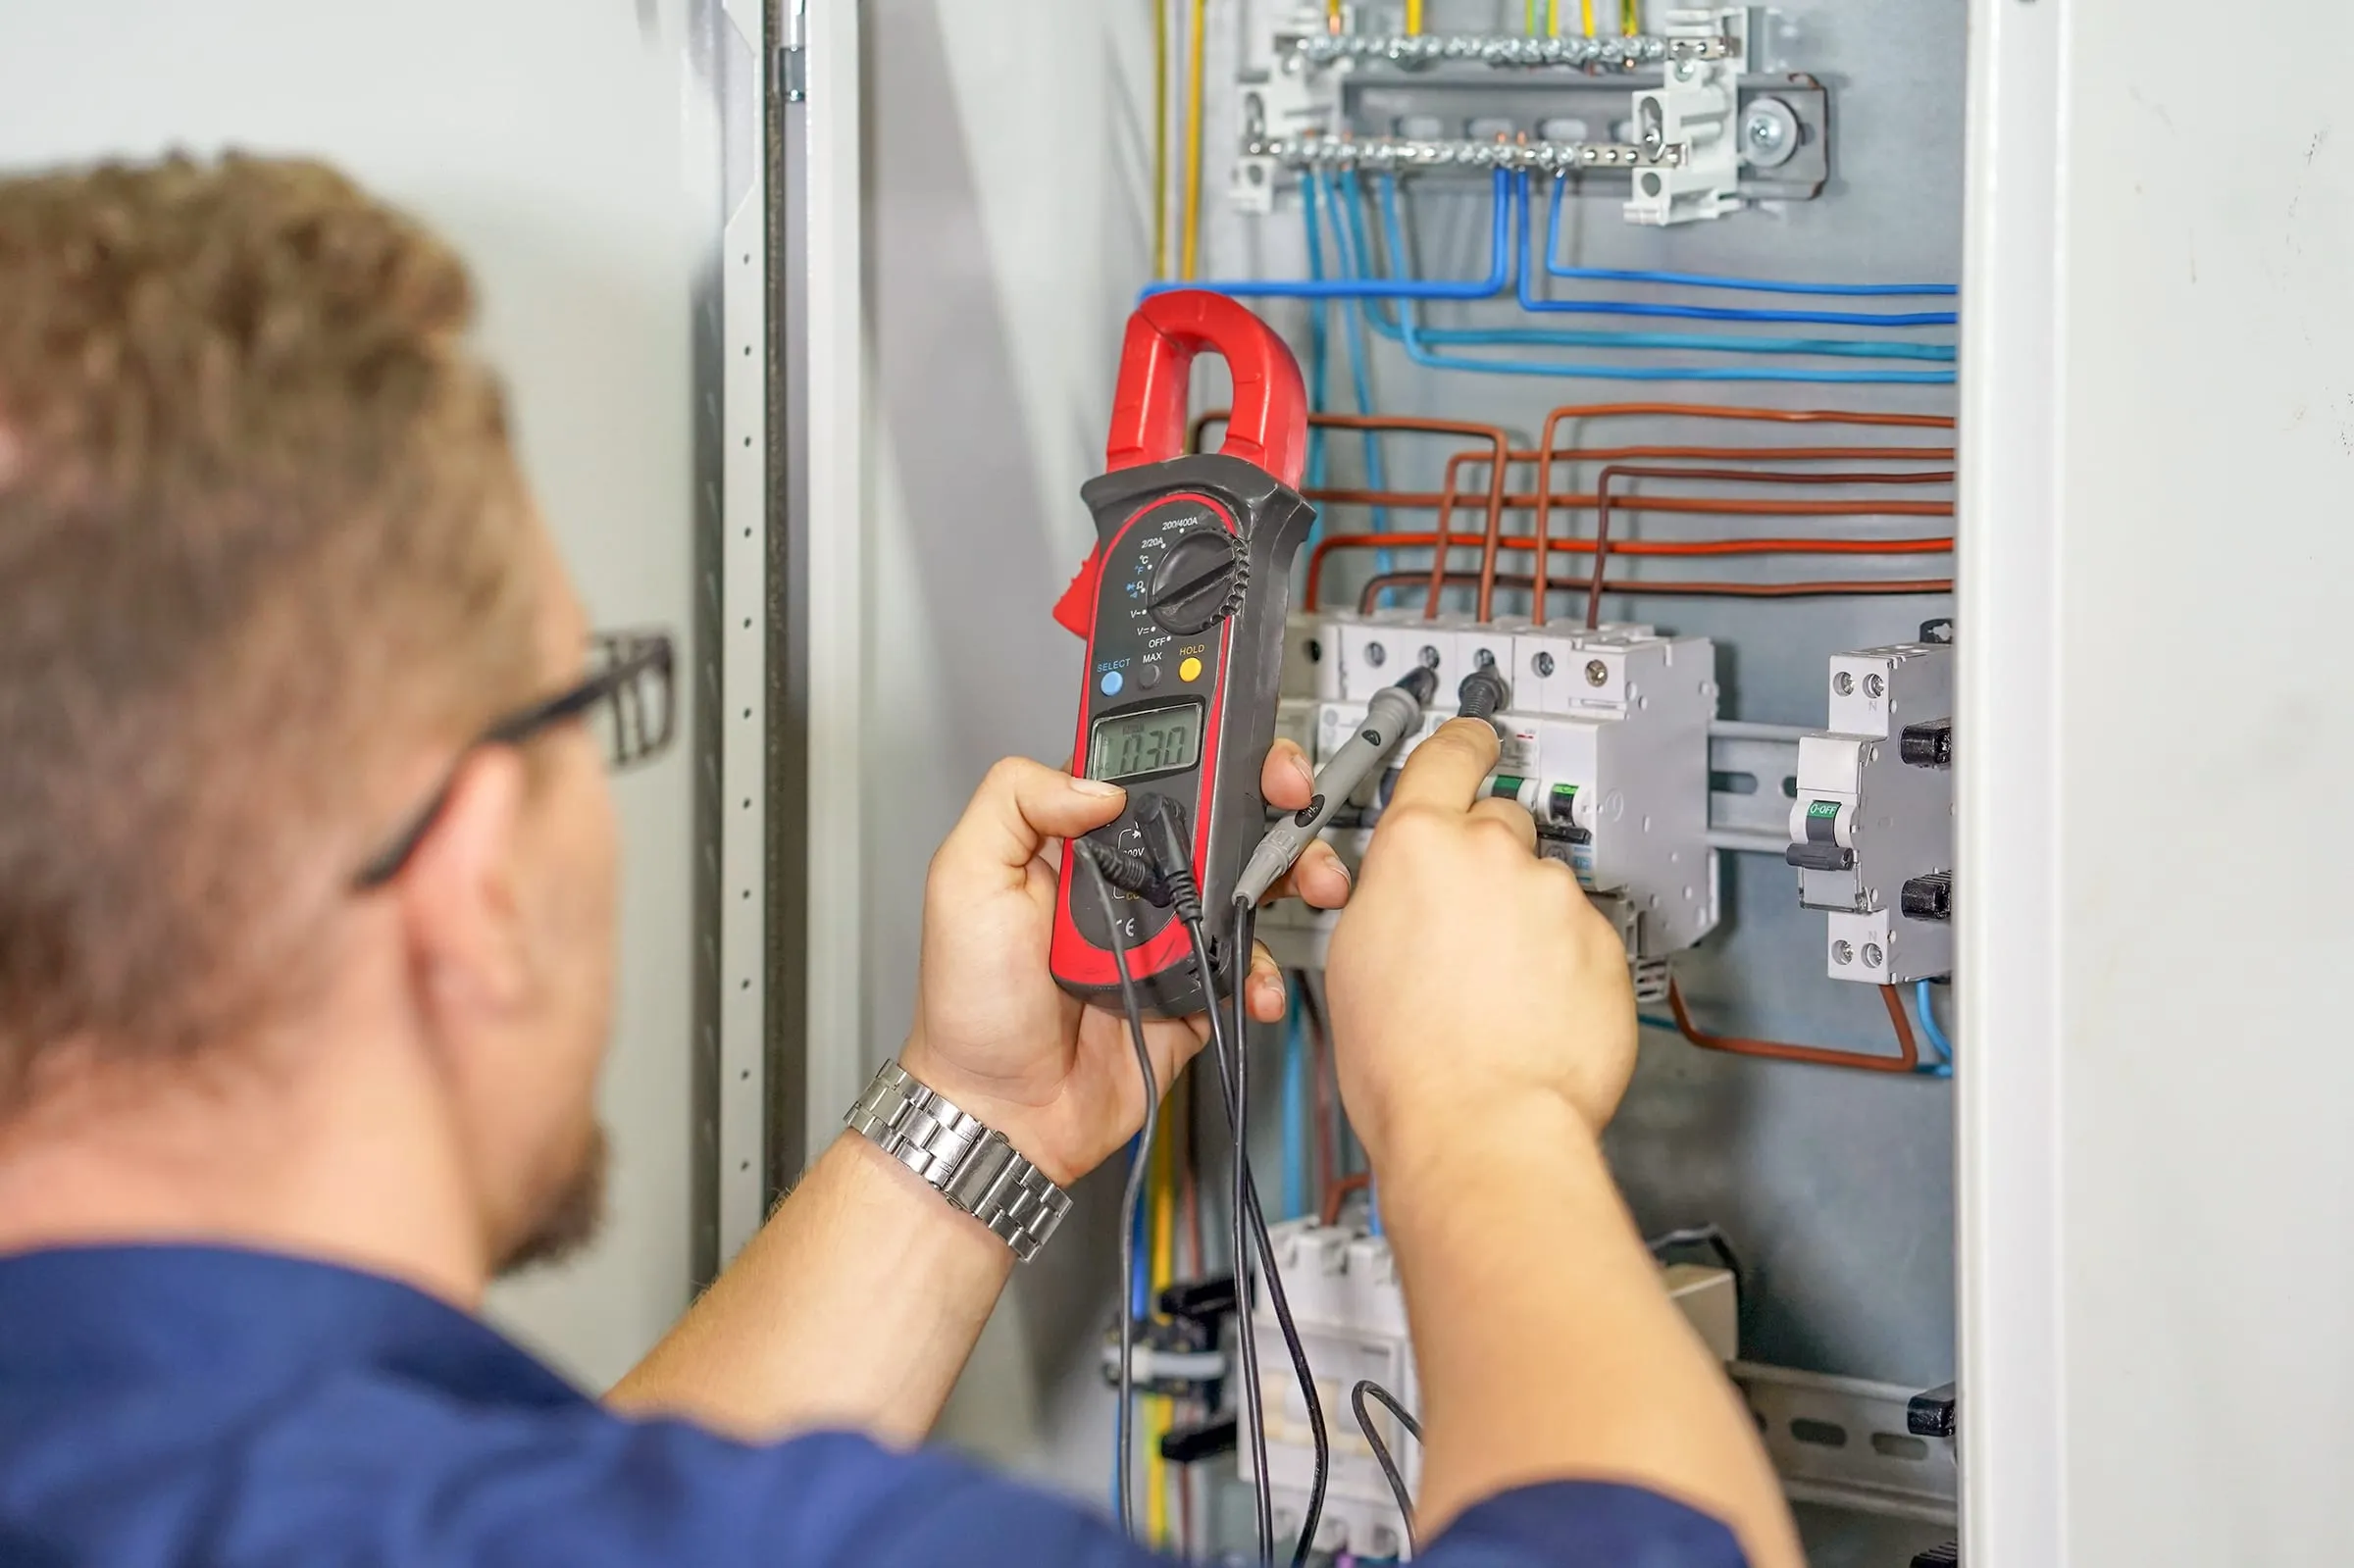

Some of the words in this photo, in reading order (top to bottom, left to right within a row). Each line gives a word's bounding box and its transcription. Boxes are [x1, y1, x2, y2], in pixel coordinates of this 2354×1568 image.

[1161, 517, 1198, 531] 200/400A
[1141, 536, 1163, 548] 2/20A
[1149, 637, 1166, 648] OFF
[1179, 644, 1205, 656] HOLD
[1142, 651, 1162, 663] MAX
[1097, 658, 1131, 673] SELECT
[1868, 701, 1877, 712] N
[1868, 930, 1878, 942] N
